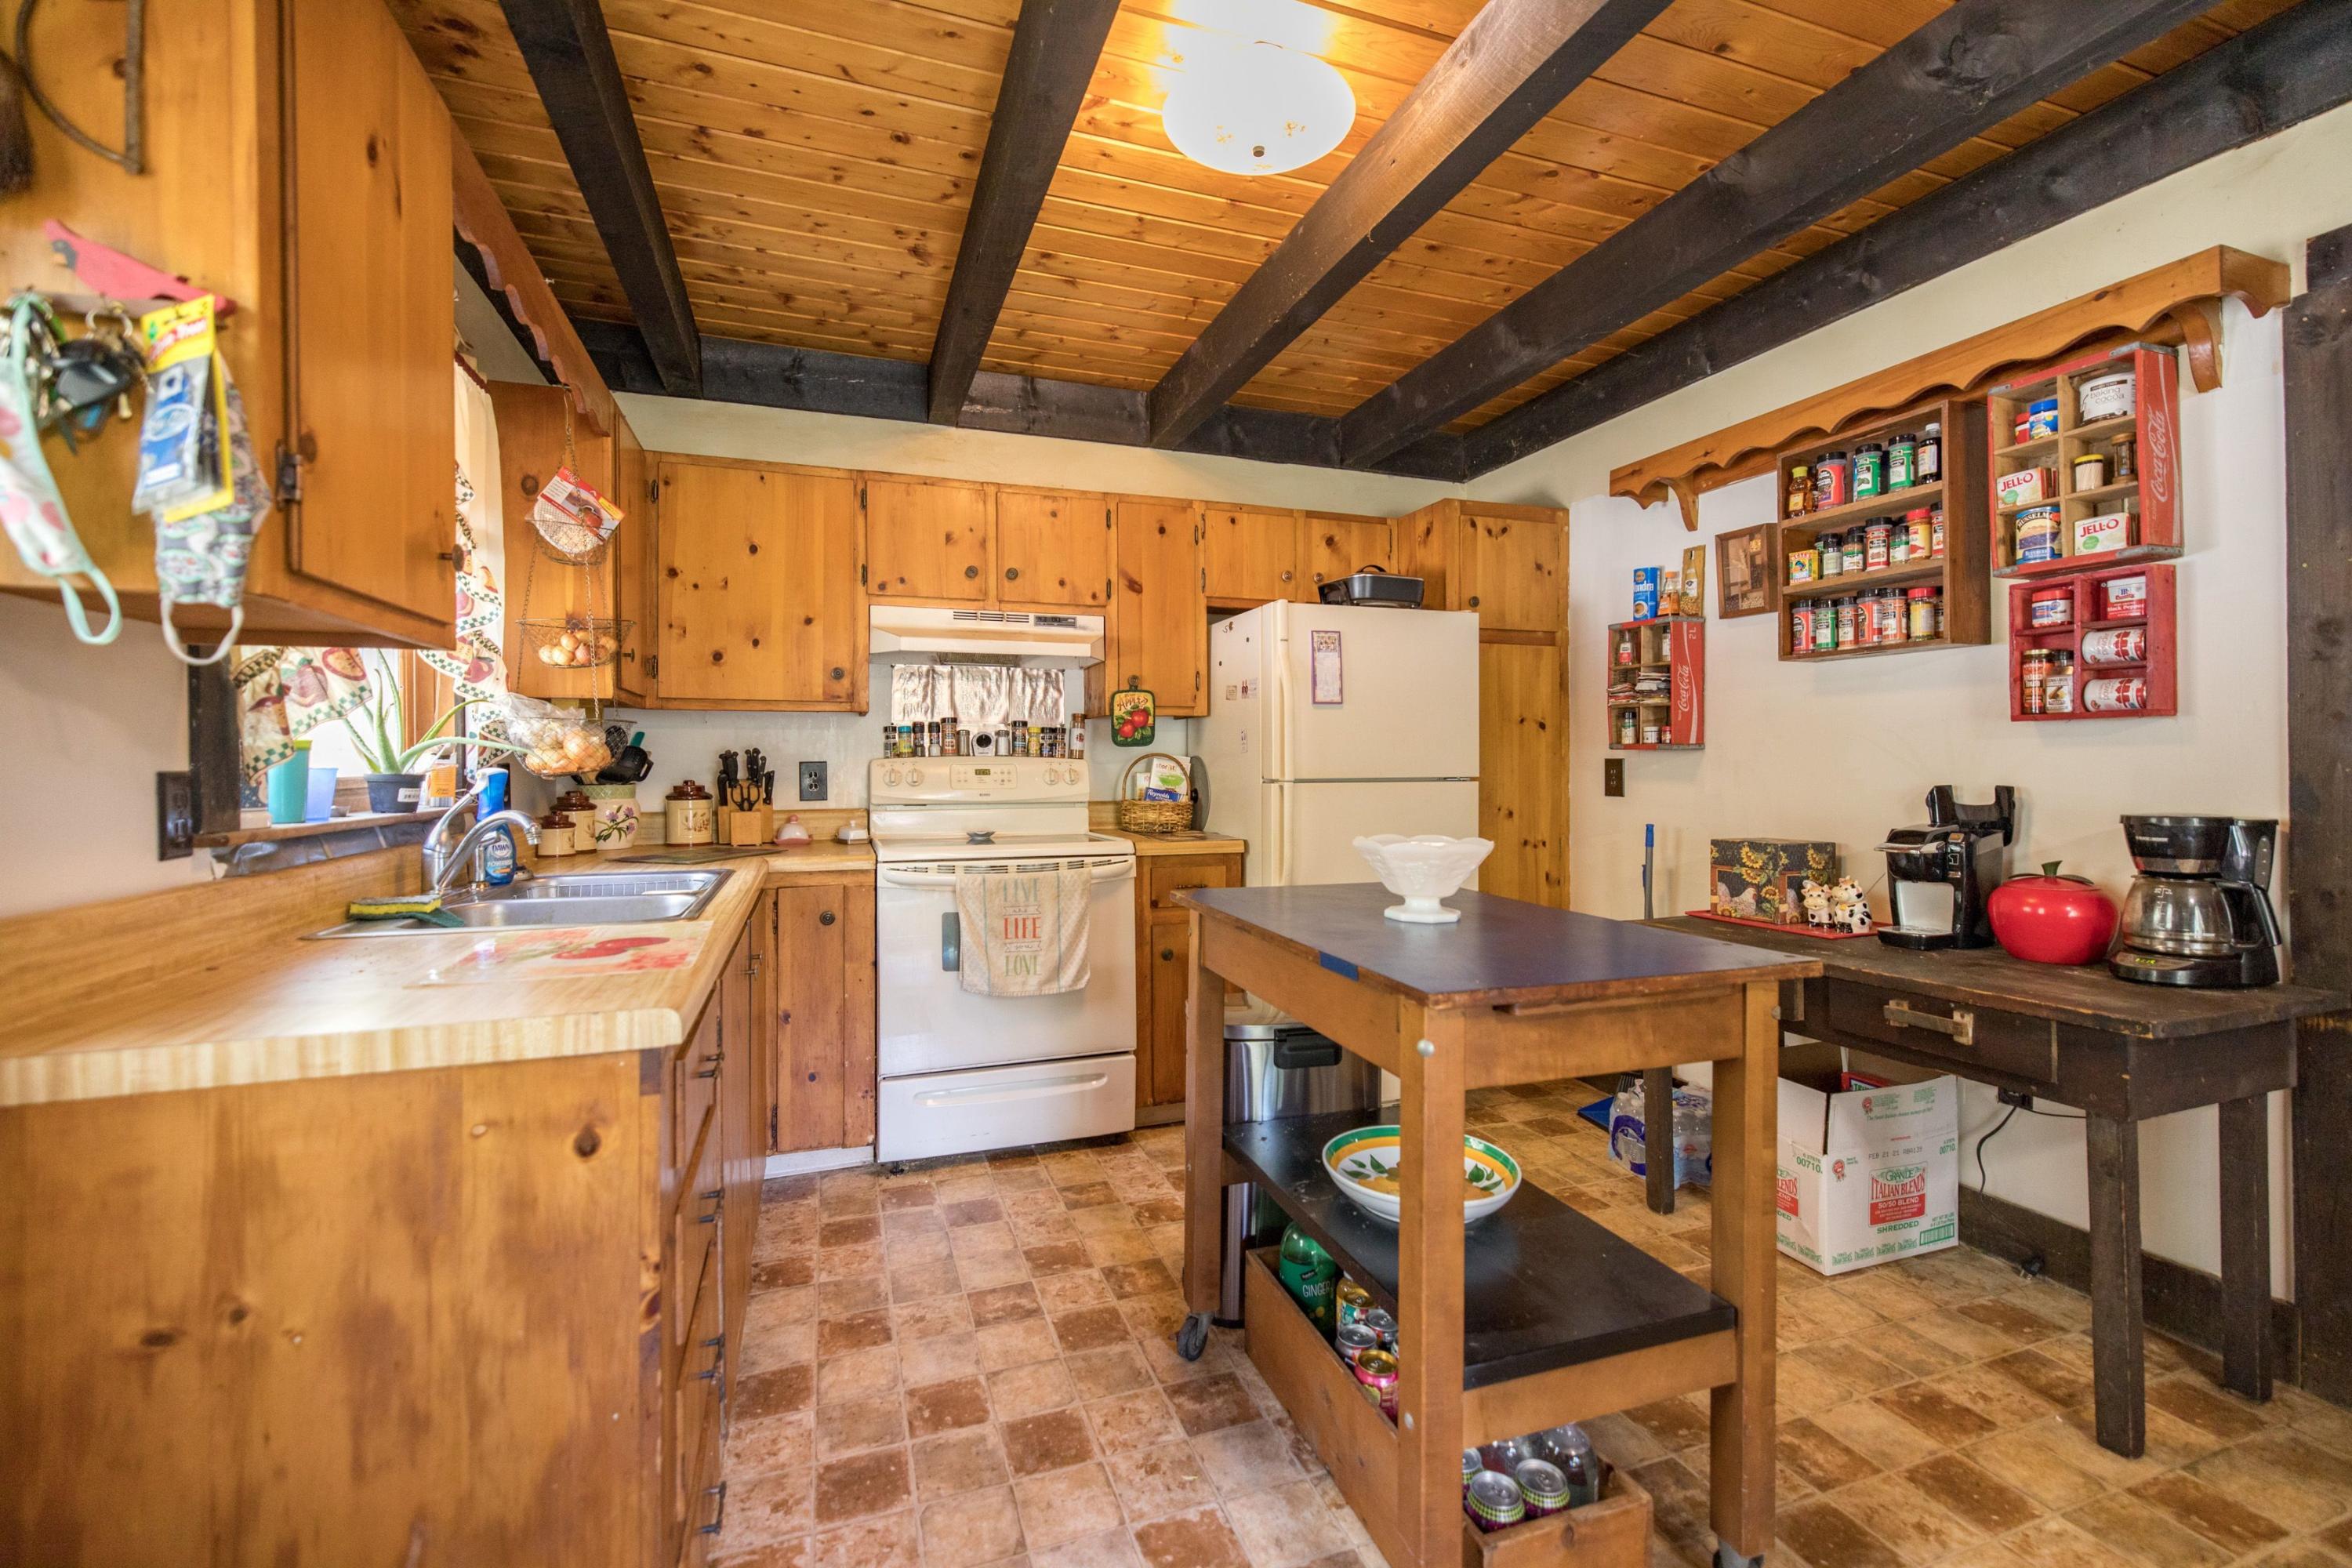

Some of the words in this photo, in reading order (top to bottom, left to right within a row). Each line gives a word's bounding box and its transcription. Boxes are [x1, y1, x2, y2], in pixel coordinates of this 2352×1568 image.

[2090, 387, 2121, 399] baking
[2095, 394, 2125, 405] cocoa
[1147, 789, 1170, 798] Reynolds
[1004, 877, 1040, 902] LIVE
[1004, 916, 1042, 939] LIFE
[1004, 954, 1042, 977] LOVE
[1886, 1168, 1914, 1181] GRANDE
[1871, 1176, 1900, 1200] ITALIAN
[1900, 1167, 1926, 1196] BLENDS
[1878, 1200, 1896, 1209] 50/50
[1897, 1196, 1919, 1206] BLEND
[1876, 1221, 1919, 1234] SHREDDED
[1302, 1280, 1330, 1298] GINGER
